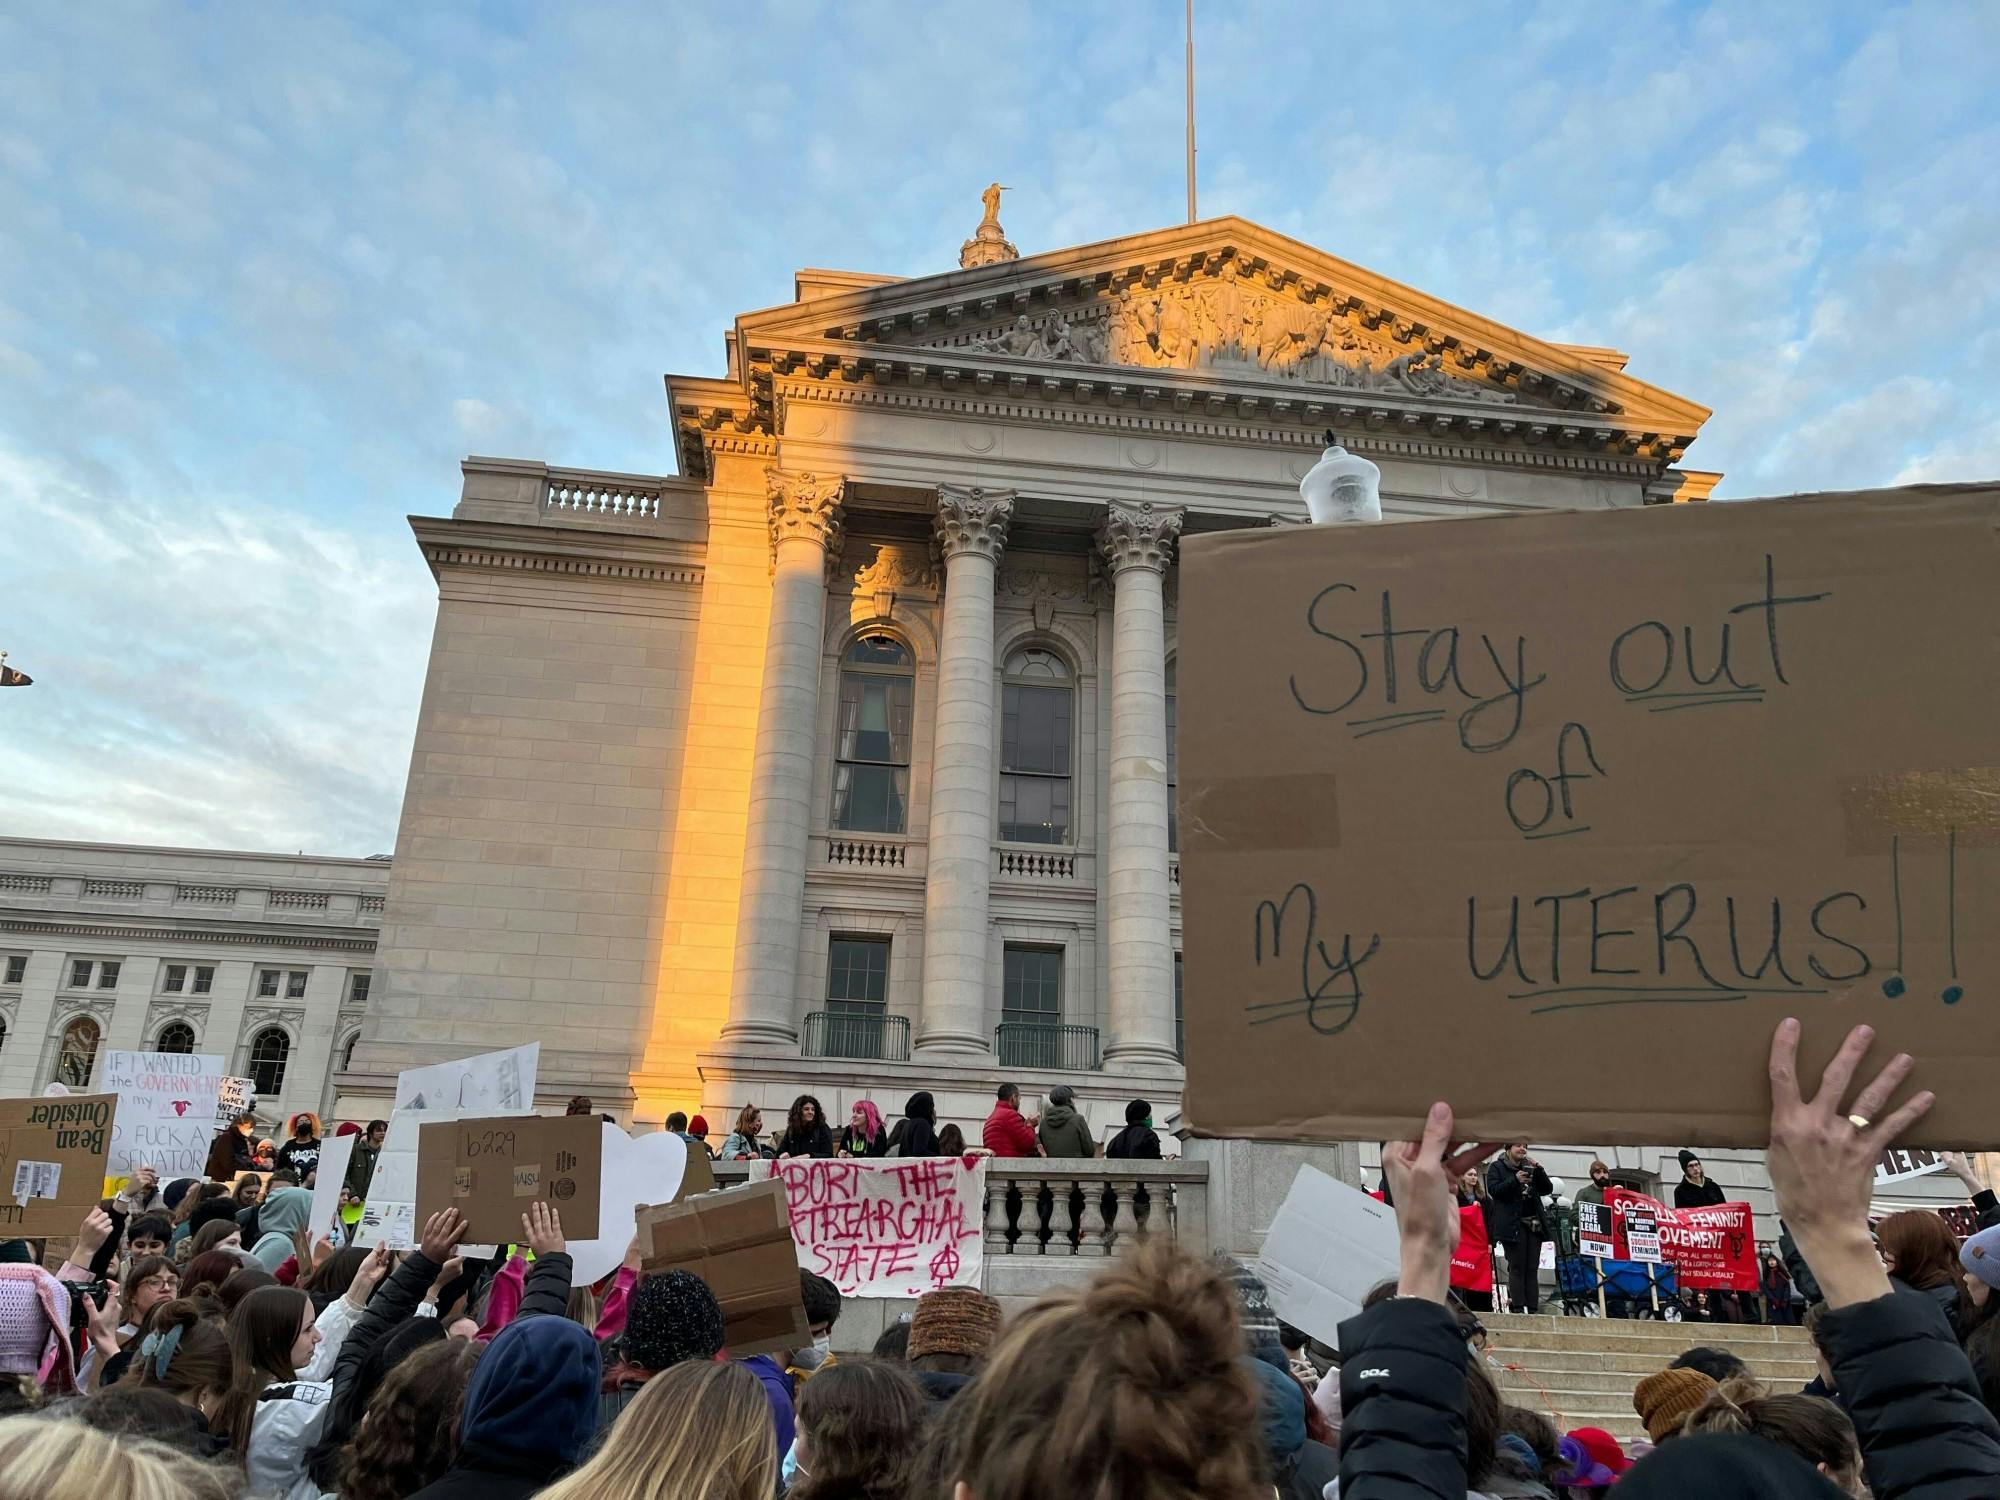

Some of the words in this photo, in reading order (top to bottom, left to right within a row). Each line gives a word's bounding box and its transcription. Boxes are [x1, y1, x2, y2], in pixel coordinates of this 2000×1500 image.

[1290, 583, 1546, 753] Stay
[1608, 553, 1834, 693] out
[1505, 722, 1606, 832] of
[1254, 884, 1381, 1034] My
[1467, 825, 1965, 1005] UTERUS!!
[109, 1052, 124, 1071] IF
[130, 1054, 135, 1072] I
[142, 1054, 202, 1075] WANTED
[110, 1073, 132, 1088] the
[132, 1096, 153, 1110] my
[26, 1101, 110, 1130] Outsider
[135, 1125, 183, 1146] FUCK
[190, 1126, 207, 1147] A
[115, 1148, 203, 1173] SENATOR
[882, 1159, 957, 1200] THE
[1580, 1203, 1598, 1215] FREE
[1580, 1212, 1598, 1224] SAFE
[1688, 1211, 1746, 1228] FEMINIST
[1580, 1221, 1602, 1234] LEGAL
[1631, 1238, 1658, 1247] SOCIALIST
[1657, 1225, 1725, 1249] OVEMENT
[1590, 1242, 1607, 1253] NOW!
[1631, 1246, 1659, 1255] FEMINISM
[1677, 1250, 1689, 1258] FOR
[811, 1242, 919, 1283] STATE
[1450, 1258, 1475, 1270] America
